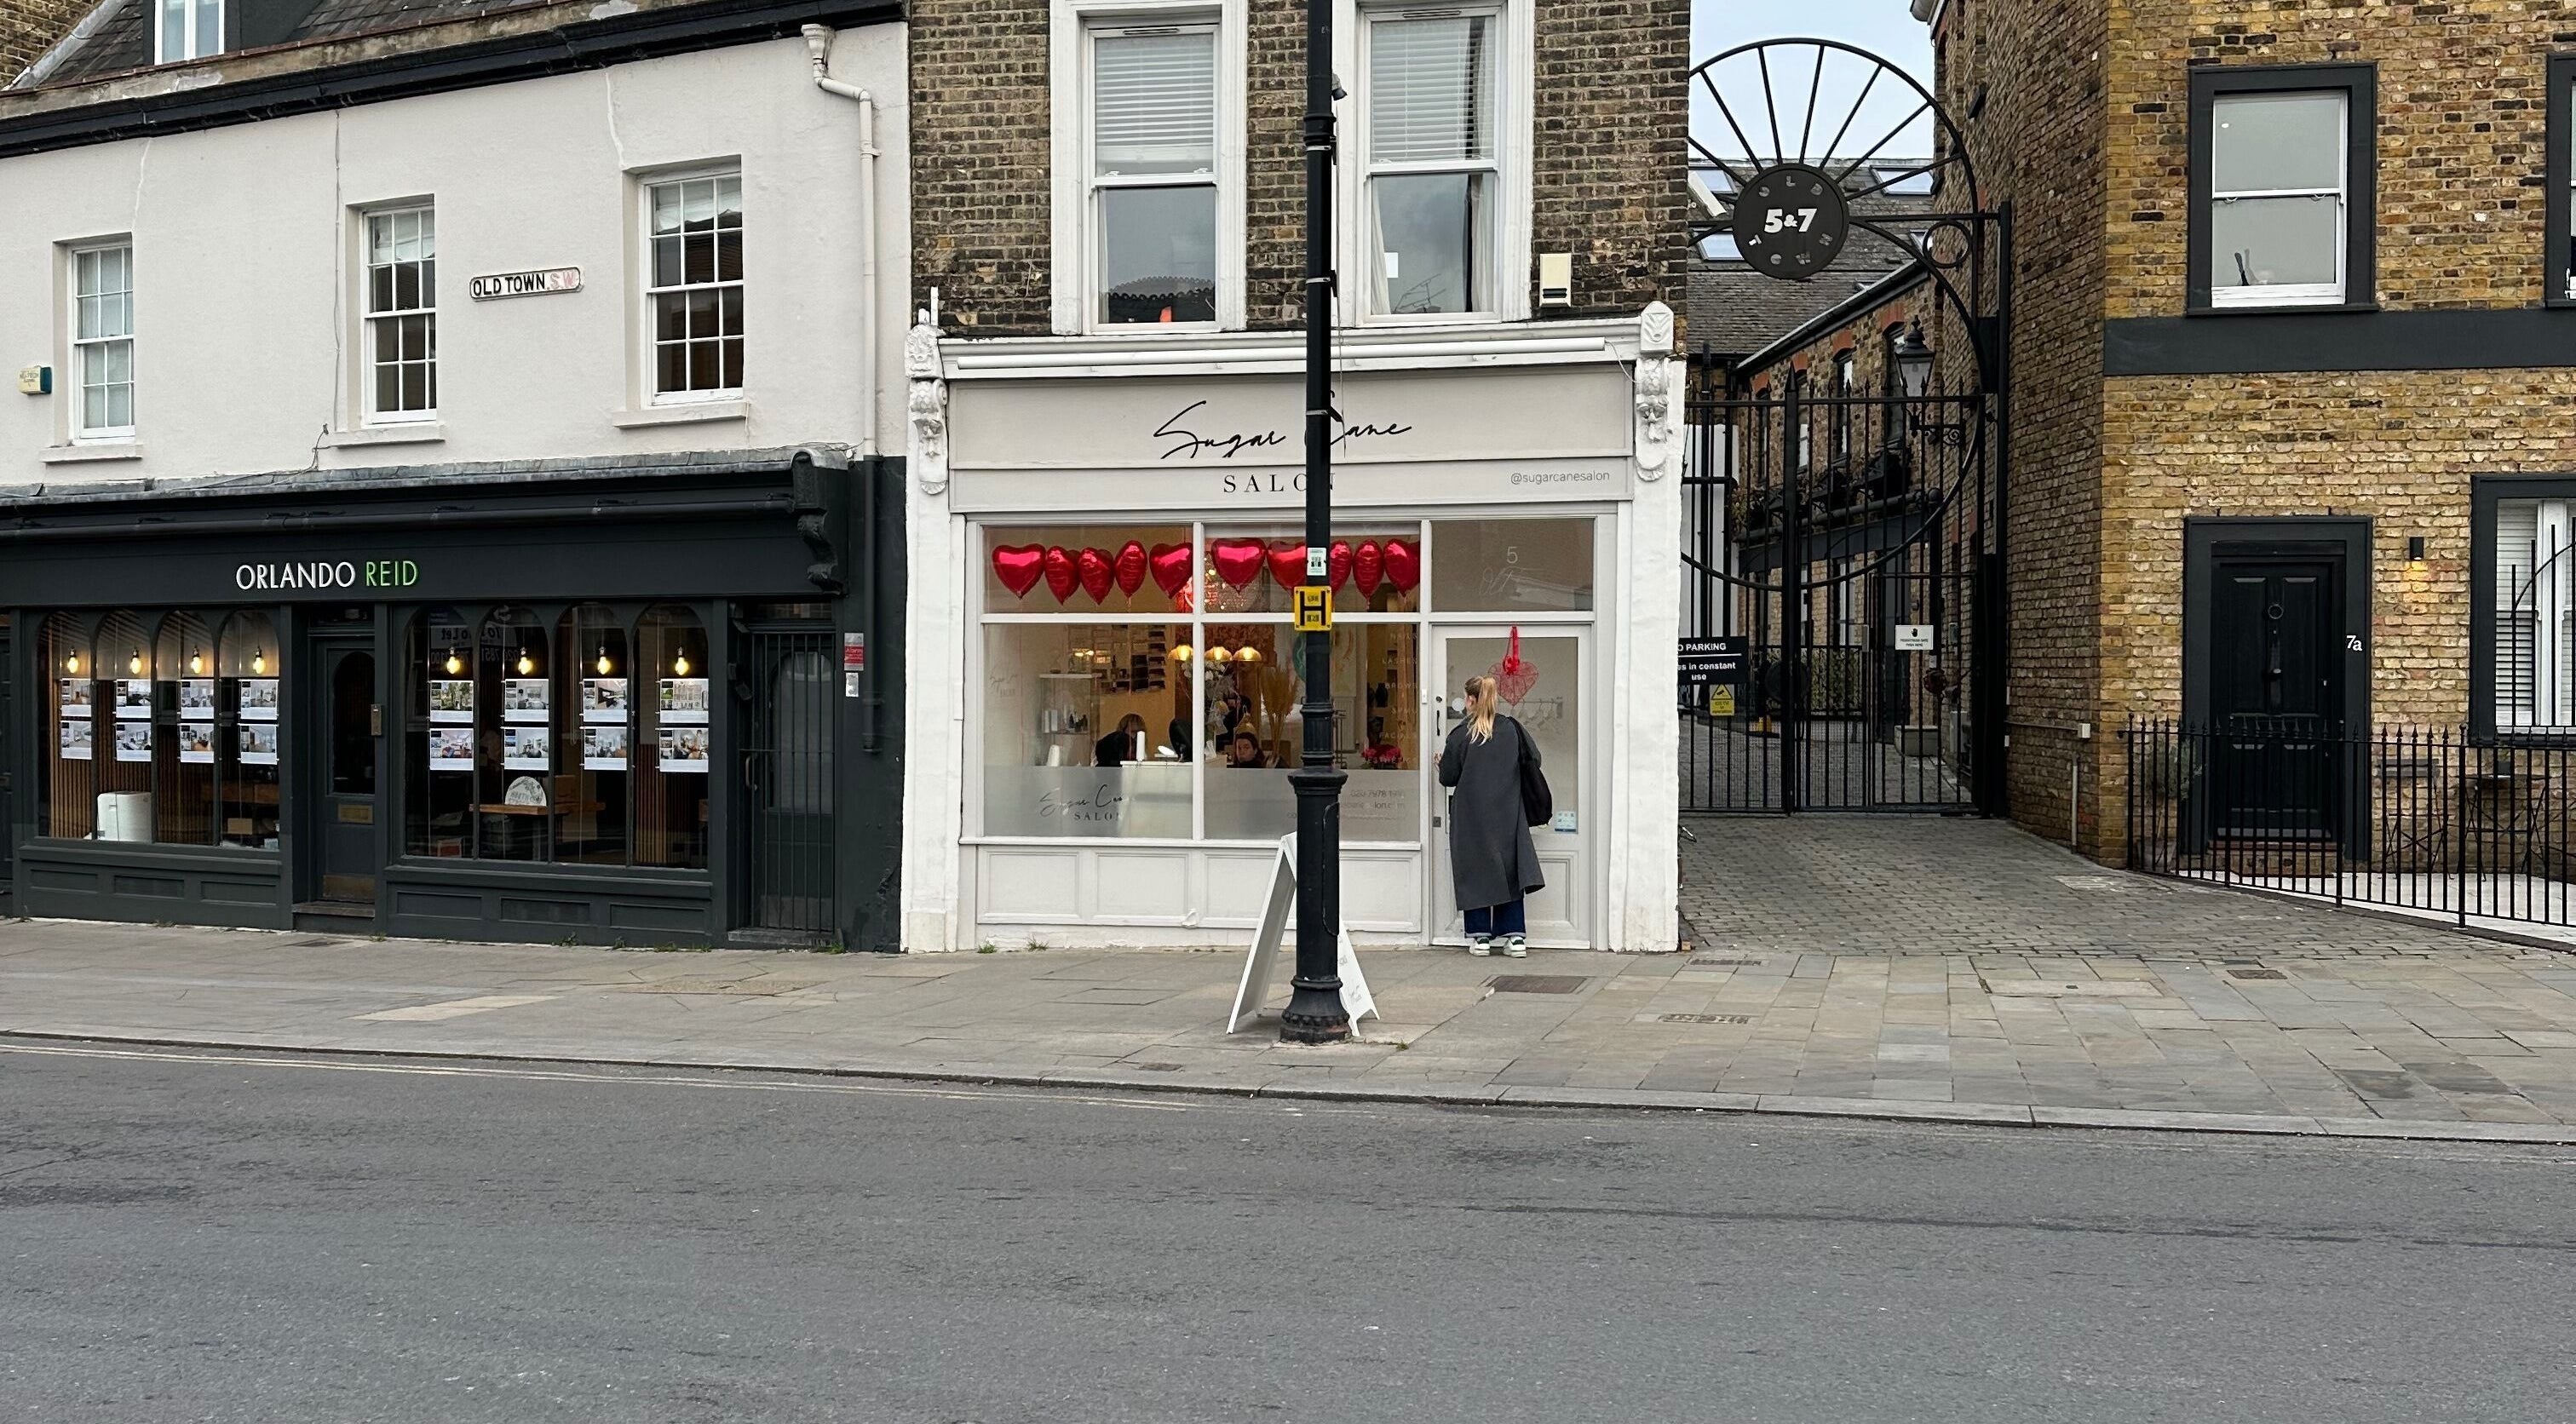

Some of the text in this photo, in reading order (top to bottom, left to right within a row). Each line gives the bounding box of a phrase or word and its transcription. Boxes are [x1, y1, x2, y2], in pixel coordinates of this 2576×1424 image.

[1763, 208, 1818, 233] 5&7
[473, 278, 502, 296] OLD
[1153, 399, 1287, 460] Sugar
[1510, 470, 1611, 485] @sugarcanesalon
[1506, 546, 1519, 564] 5
[235, 560, 419, 589] ORLANDO REID
[1686, 642, 1727, 652] PARKING
[2346, 634, 2363, 652] 7a
[1699, 661, 1737, 670] constant
